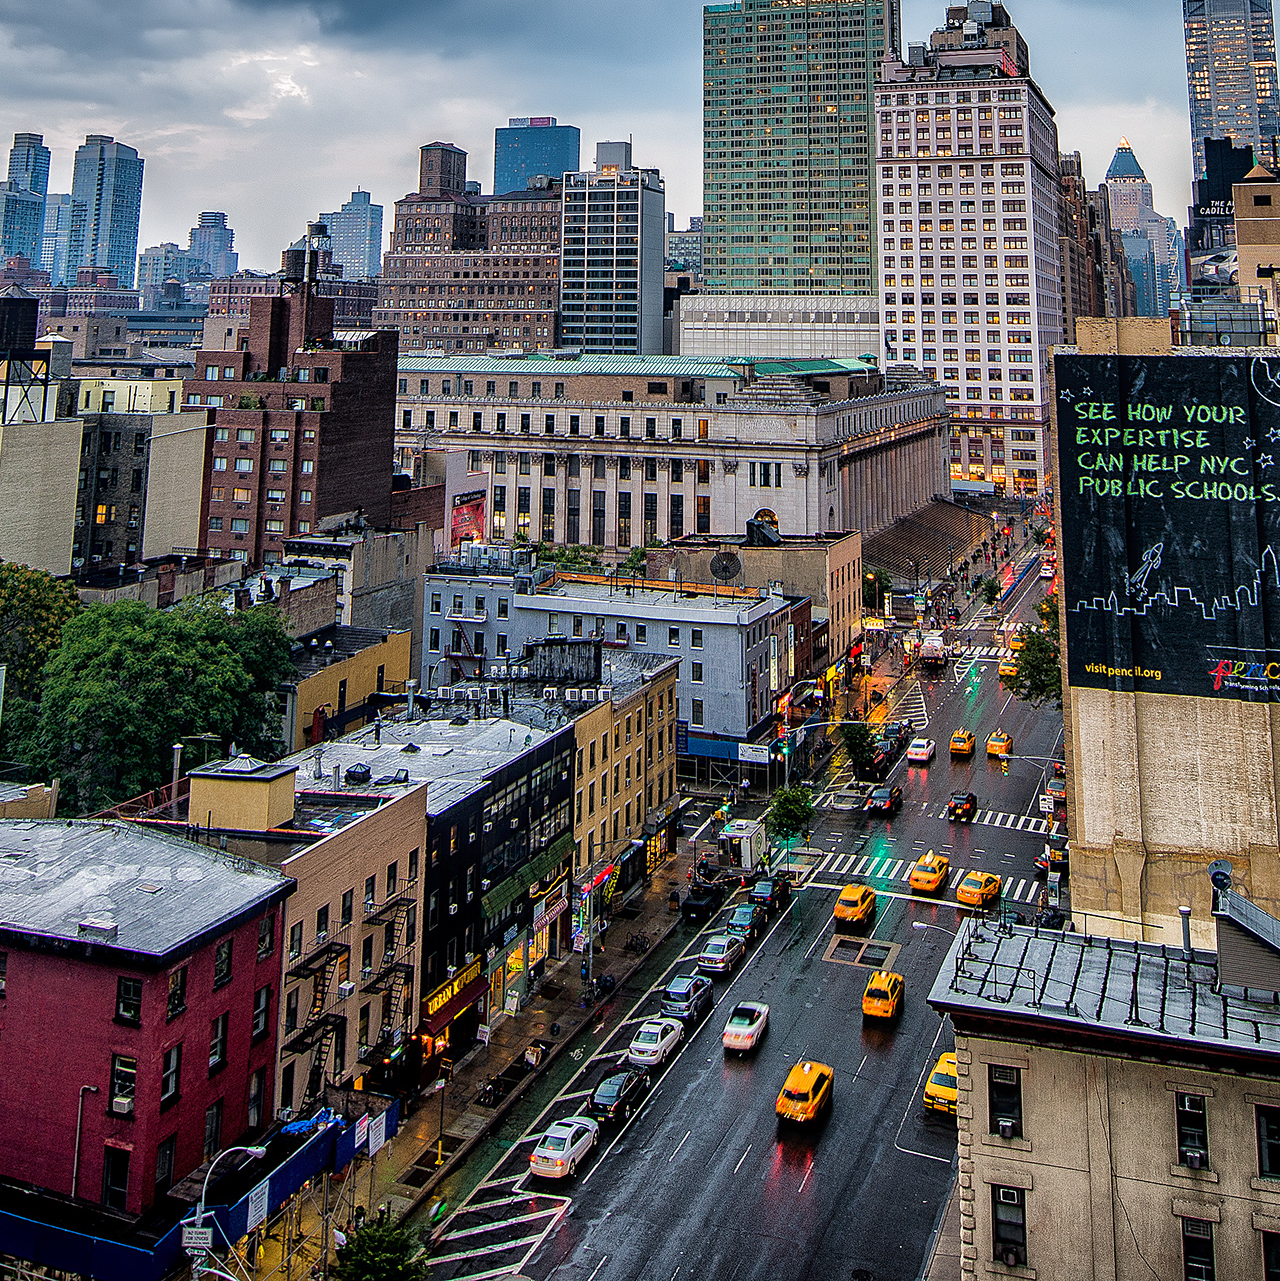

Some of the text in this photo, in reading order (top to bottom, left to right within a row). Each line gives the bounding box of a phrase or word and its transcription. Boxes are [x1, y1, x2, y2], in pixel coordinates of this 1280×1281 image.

[1074, 402, 1247, 425] SEE HOW YOUR
[1075, 426, 1211, 449] EXPERTISE
[1077, 452, 1249, 476] CAN HELP NYC
[1078, 476, 1164, 499] PUBLIC
[428, 985, 452, 1015] URBAN
